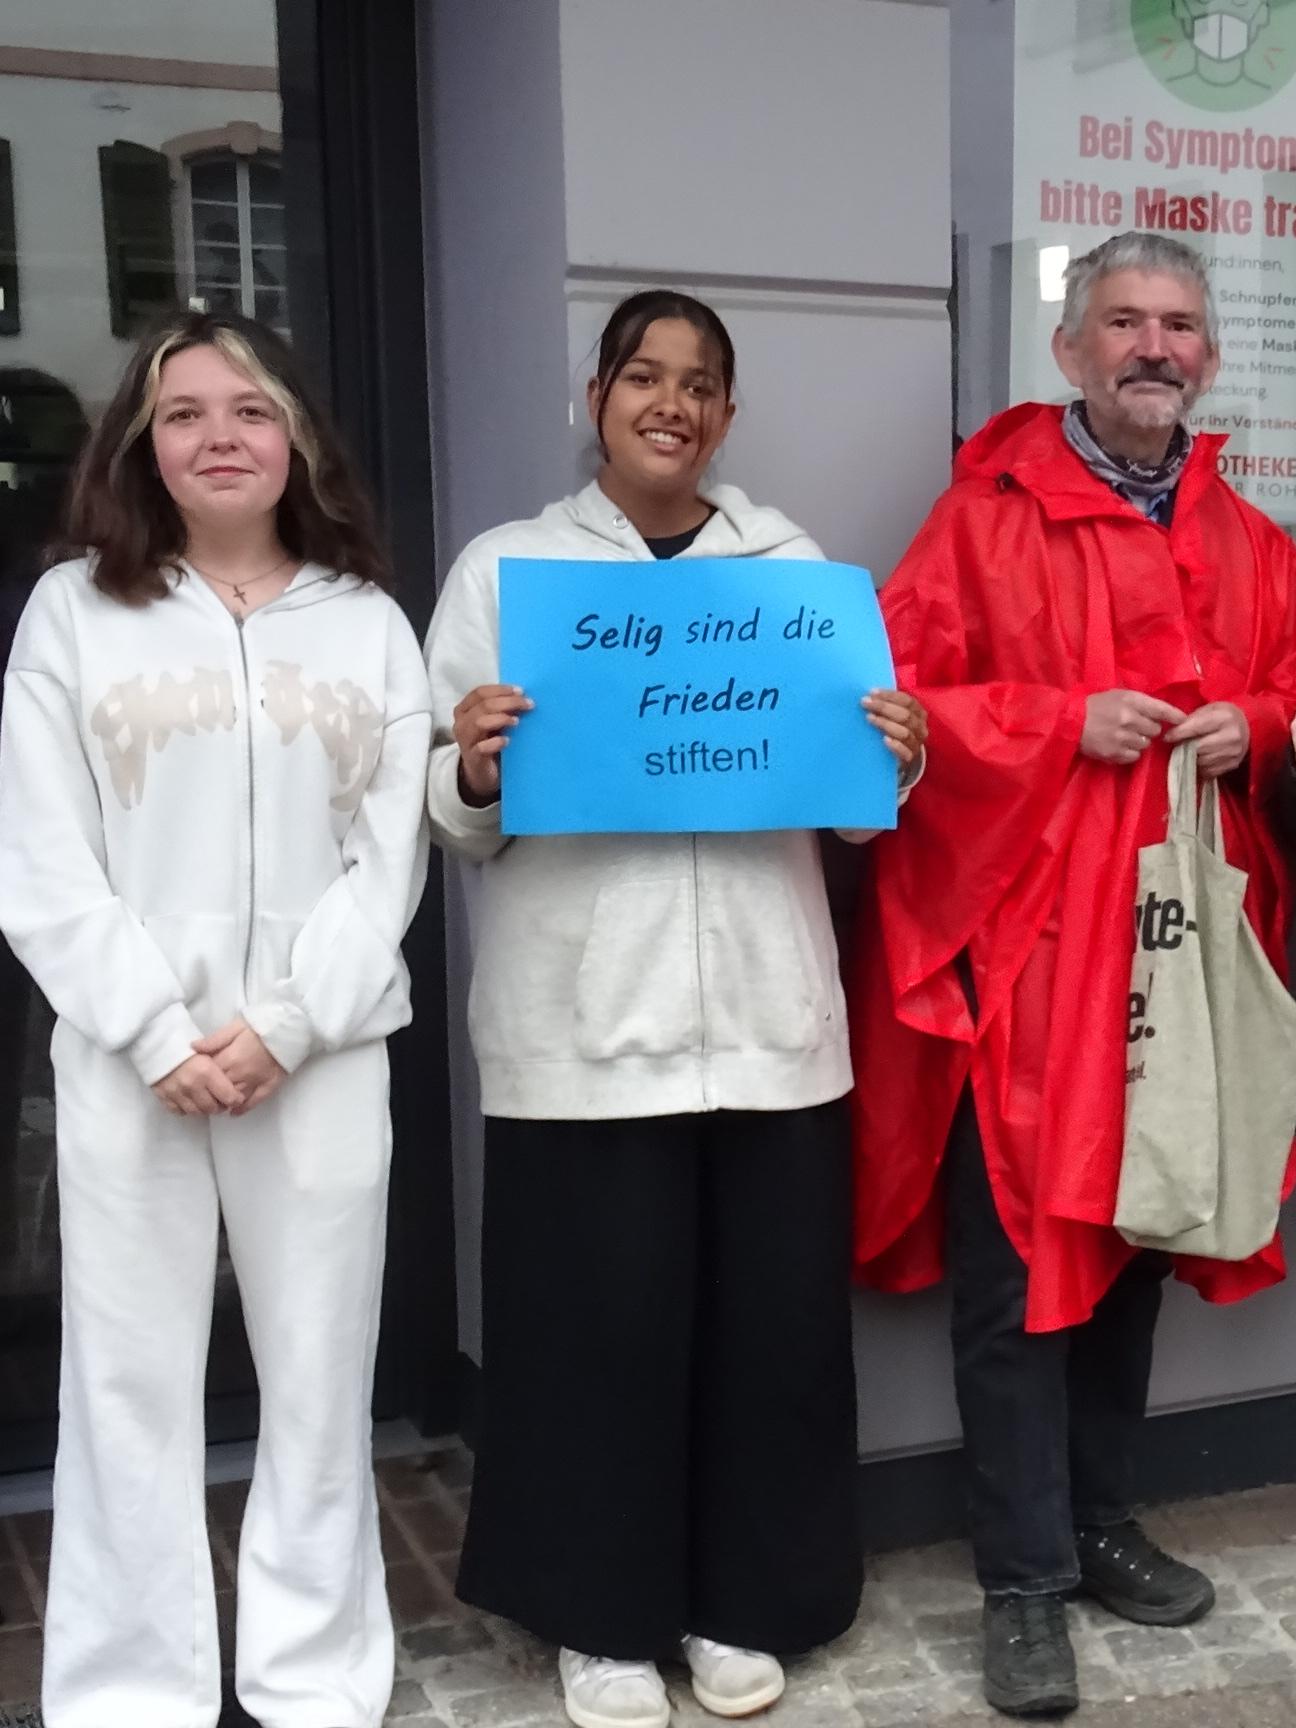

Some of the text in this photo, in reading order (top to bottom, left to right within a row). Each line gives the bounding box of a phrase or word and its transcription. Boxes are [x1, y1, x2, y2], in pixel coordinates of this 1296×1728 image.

[1078, 114, 1133, 161] Bei
[1040, 180, 1123, 227] bitte
[1134, 186, 1253, 235] Maske
[1219, 315, 1296, 330] ymptome
[1222, 360, 1246, 373] hre
[1208, 415, 1229, 427] Ihr
[571, 605, 836, 656] Selig sind die
[638, 677, 780, 718] Frieden
[644, 738, 770, 776] stiften!
